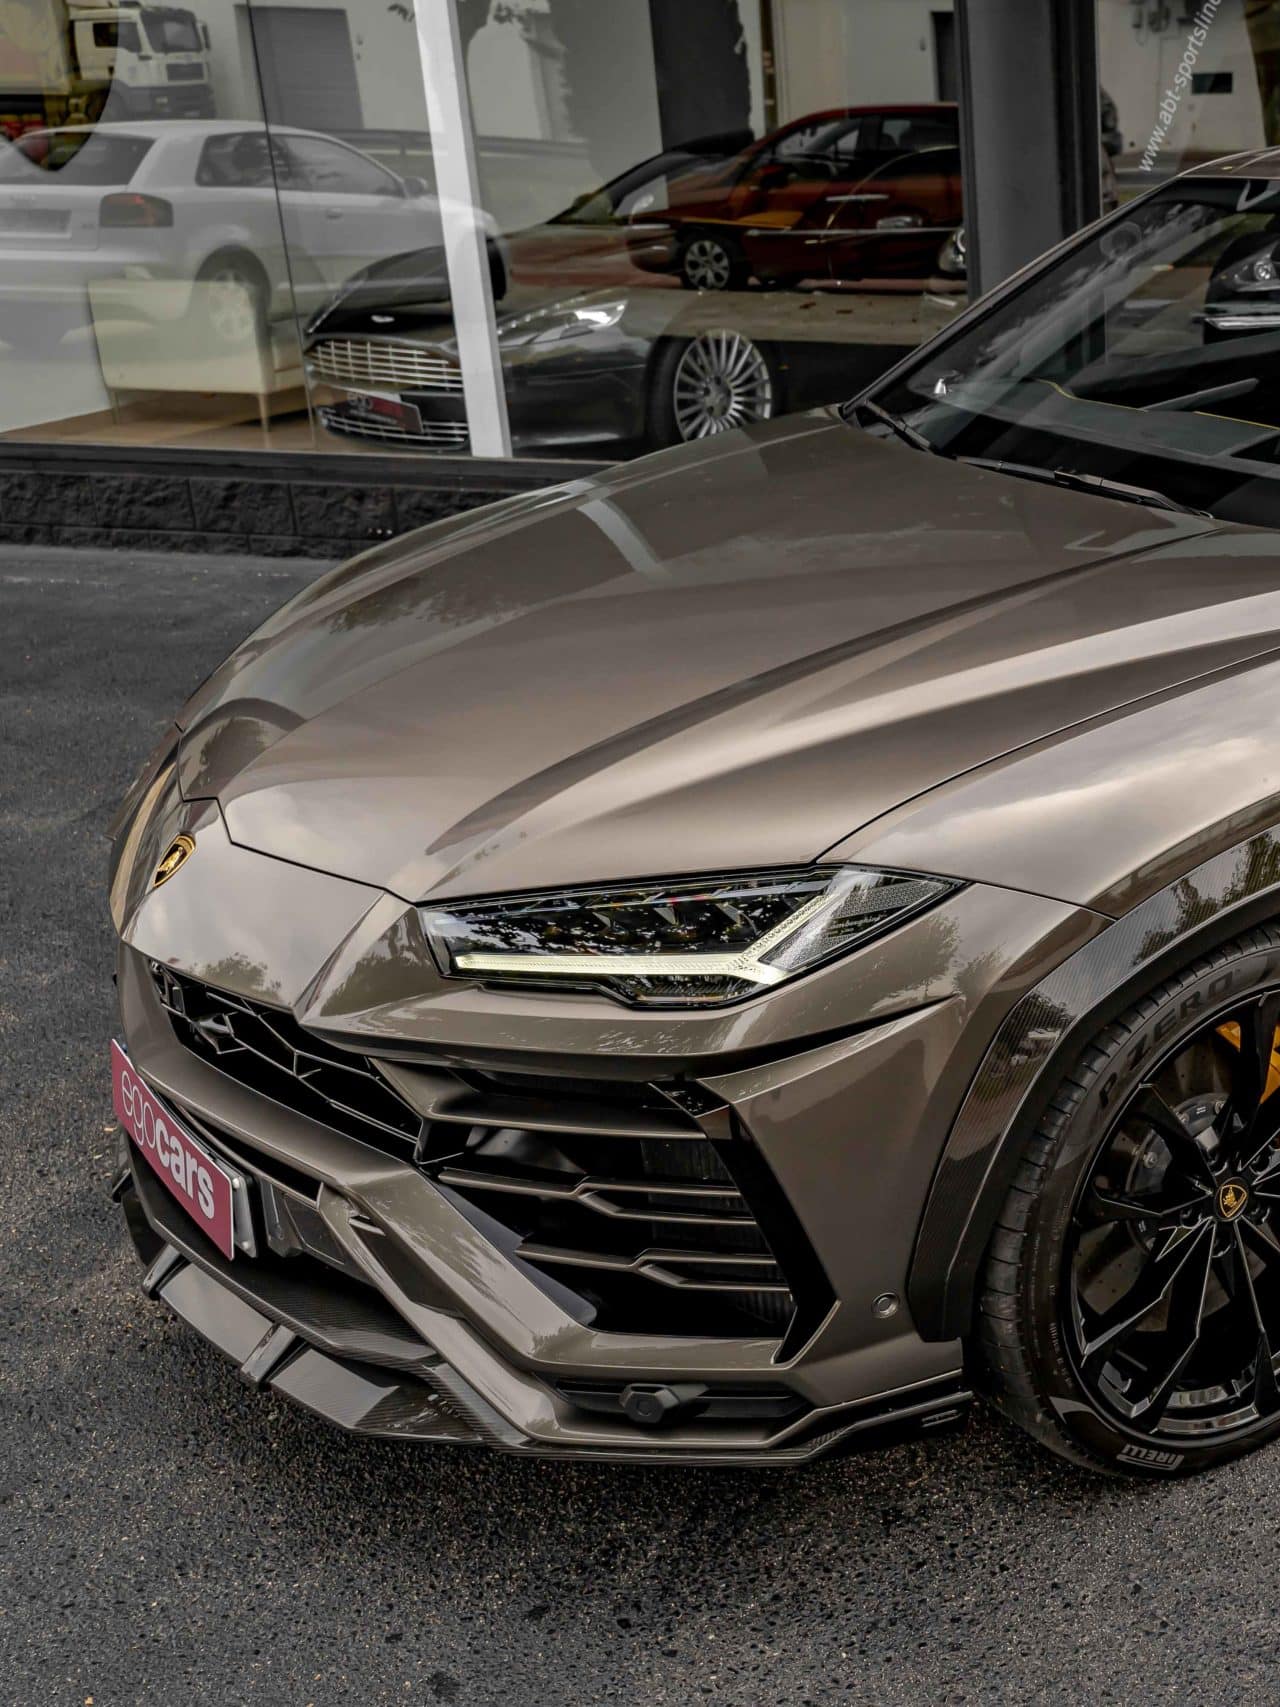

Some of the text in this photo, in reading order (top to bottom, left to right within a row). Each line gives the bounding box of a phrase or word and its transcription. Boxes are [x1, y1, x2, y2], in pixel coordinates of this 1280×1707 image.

[1099, 970, 1234, 1109] P ZERO
[121, 1069, 215, 1219] egocars
[1116, 1443, 1184, 1471] PIRELLI
